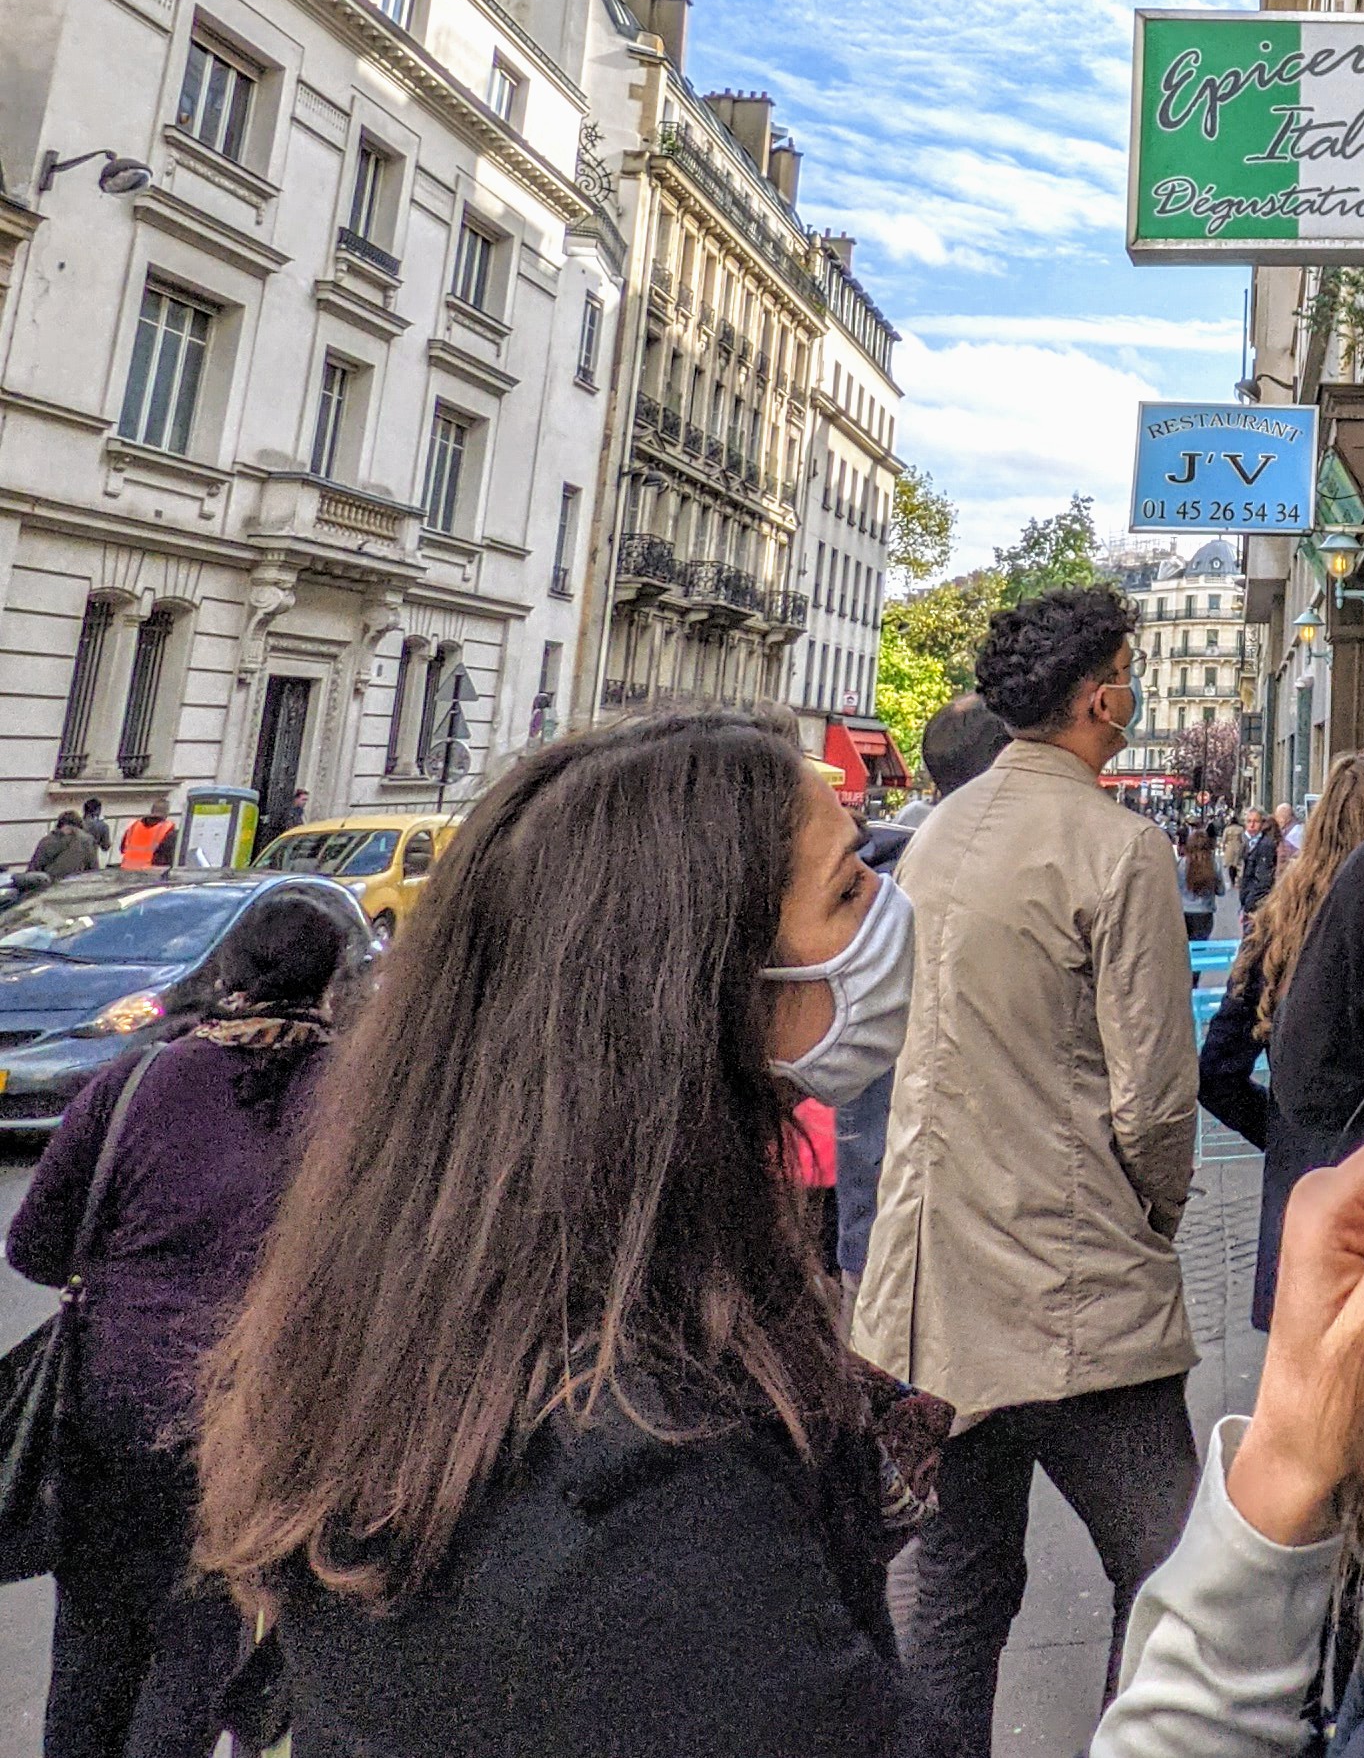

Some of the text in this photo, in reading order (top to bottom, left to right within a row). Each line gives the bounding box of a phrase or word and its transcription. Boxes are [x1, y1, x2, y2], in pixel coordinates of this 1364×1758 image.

[1147, 412, 1303, 442] RESTAURANT
[1165, 451, 1277, 485] J'V
[1143, 498, 1300, 523] 01 45 26 54 34
